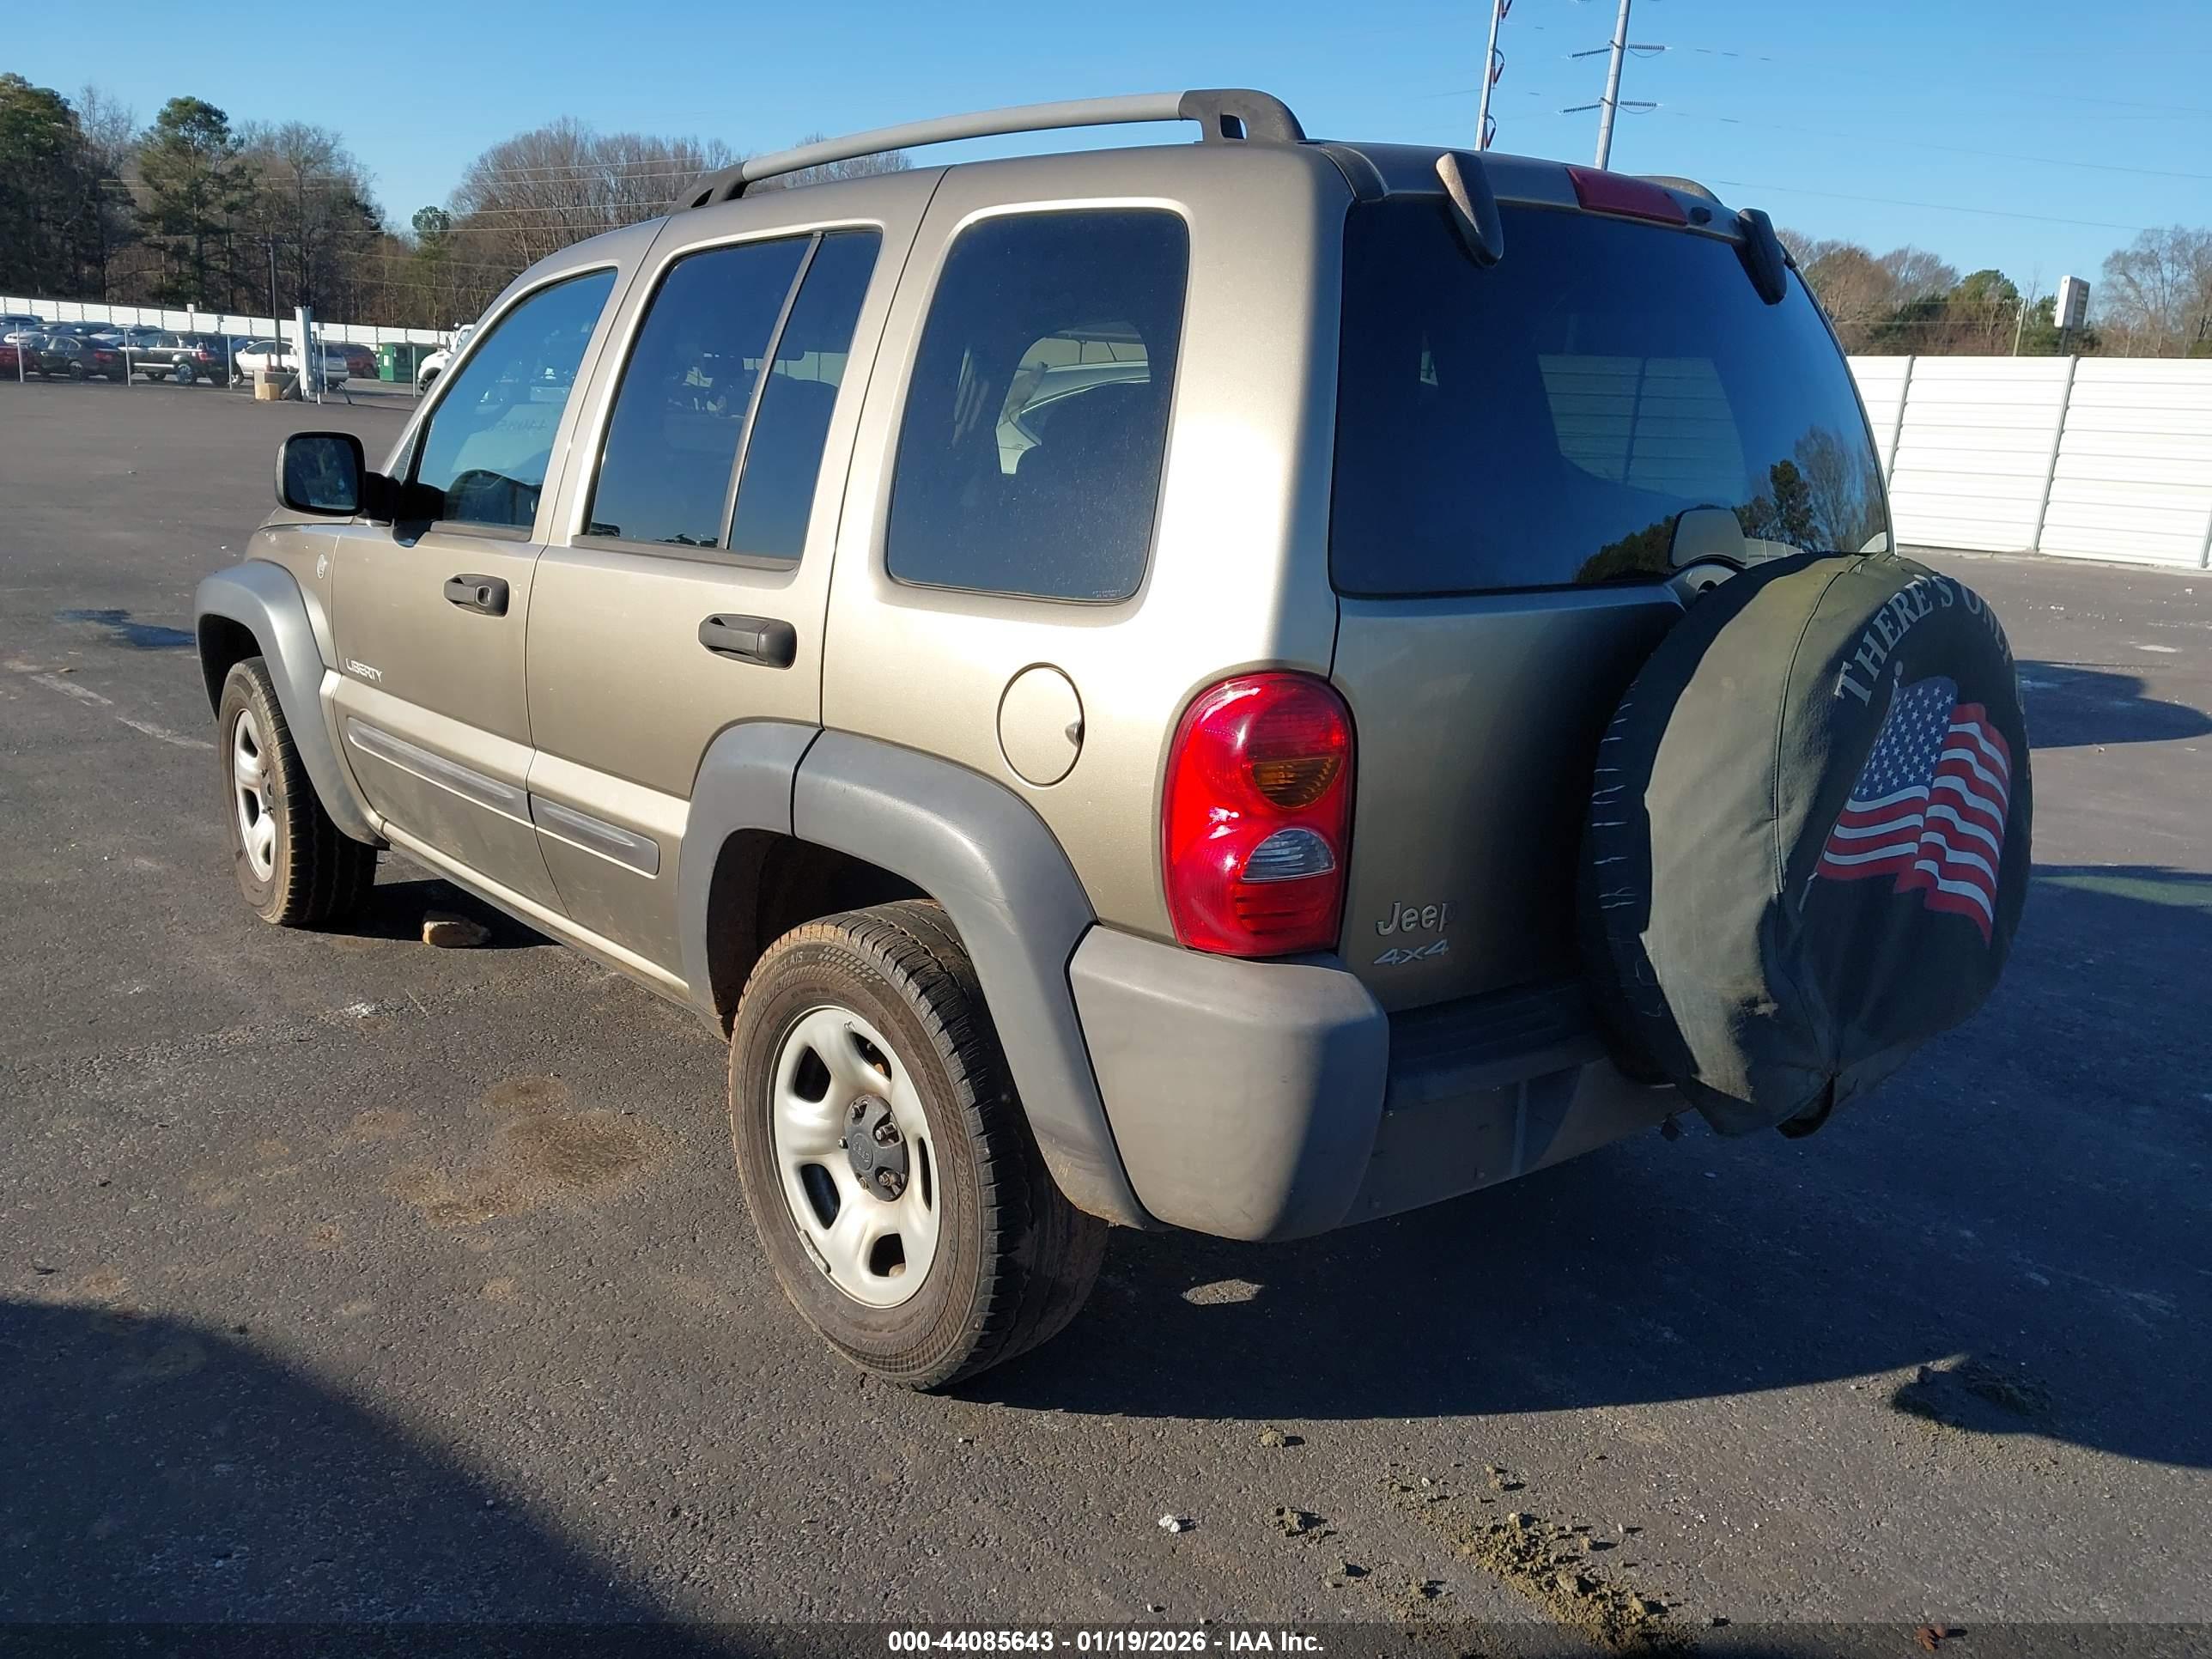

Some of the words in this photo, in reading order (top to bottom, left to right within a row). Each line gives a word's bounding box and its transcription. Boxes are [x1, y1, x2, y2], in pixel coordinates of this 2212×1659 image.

[1834, 574, 1954, 707] THERE'S
[345, 658, 382, 683] LIBERTY
[1376, 902, 1455, 935] Jeep
